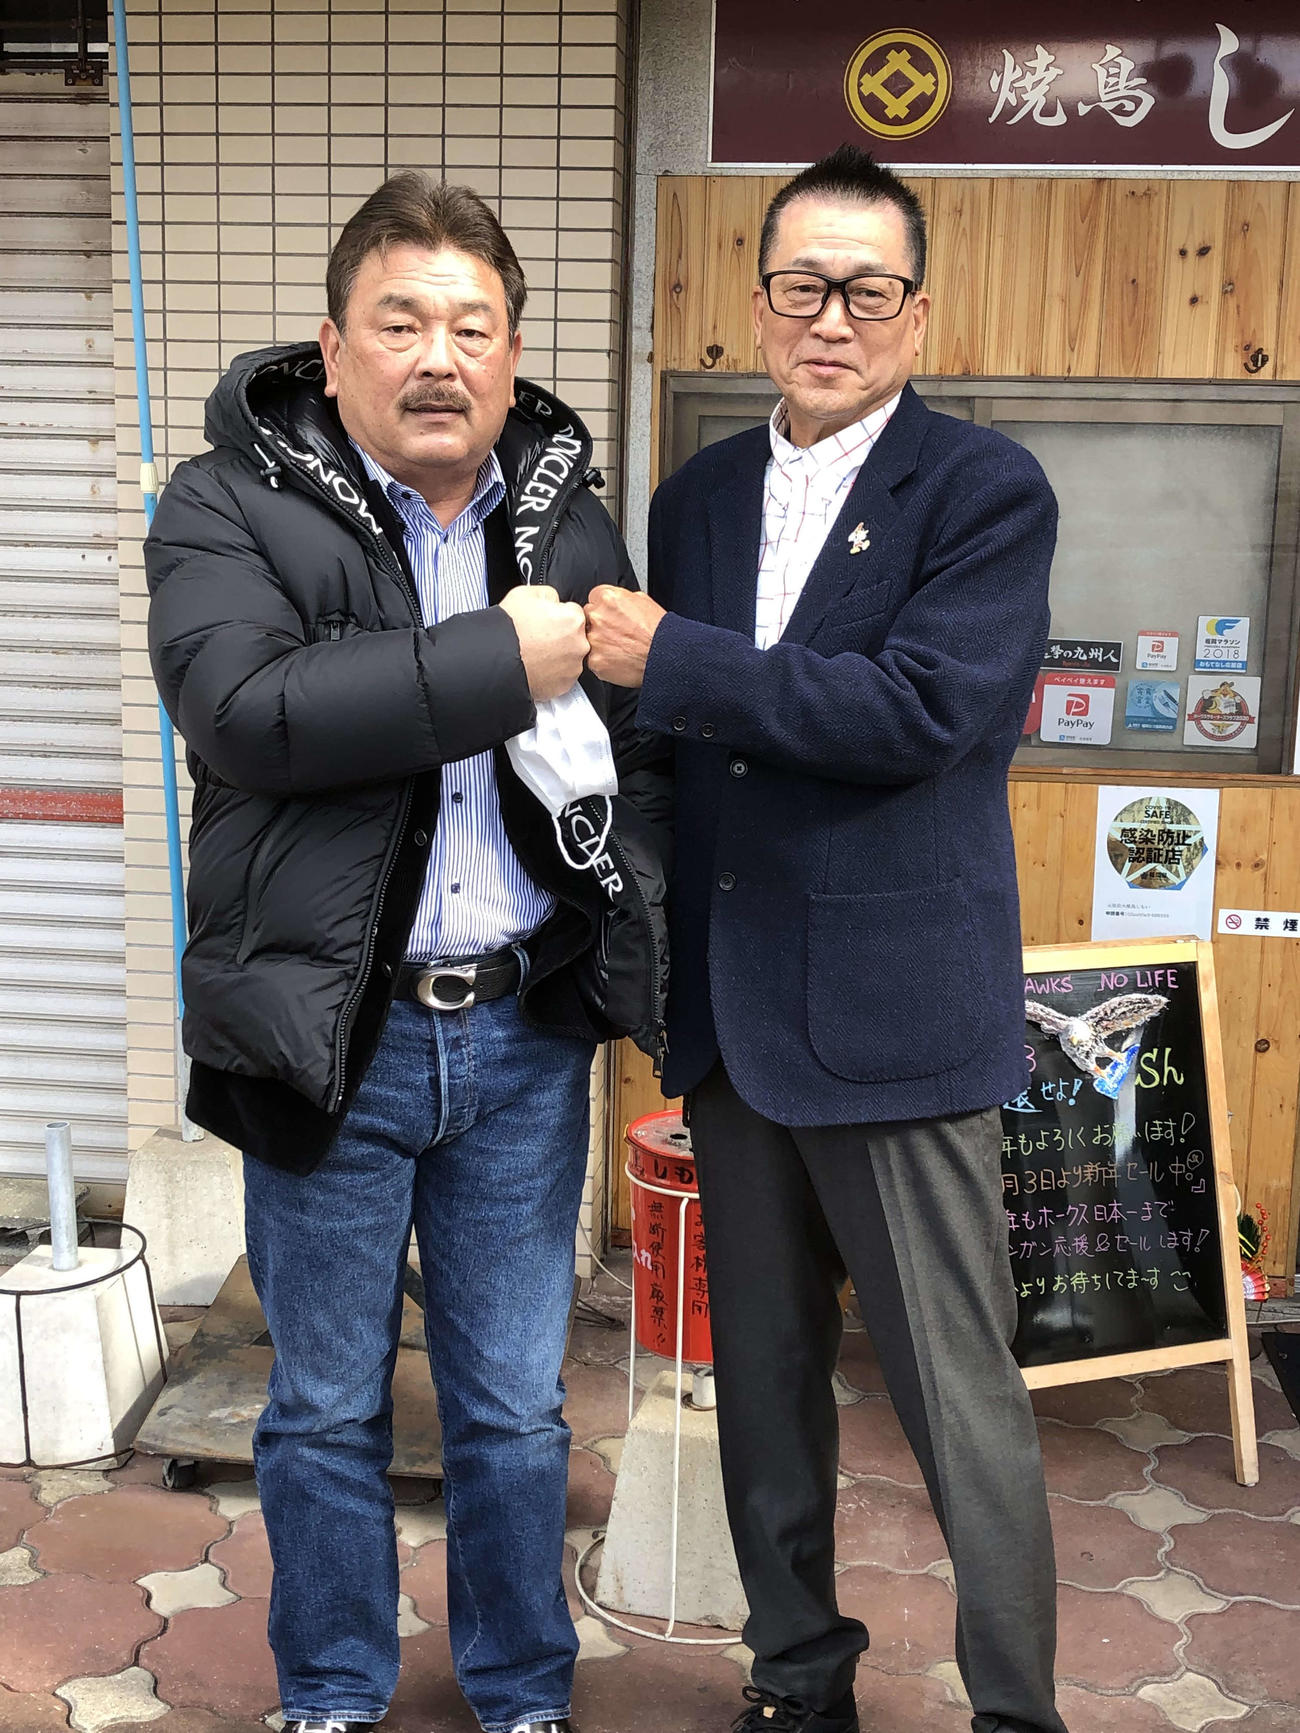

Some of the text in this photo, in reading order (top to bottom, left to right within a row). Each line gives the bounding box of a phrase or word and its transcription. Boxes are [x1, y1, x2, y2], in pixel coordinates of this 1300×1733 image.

[988, 22, 1296, 149] 焼鳥 し
[1203, 648, 1240, 659] 2018
[1057, 717, 1095, 730] PayPay
[1144, 809, 1171, 819] SAFE
[1120, 827, 1192, 846] 感染防止
[1128, 846, 1182, 865] 認証店
[1097, 972, 1129, 991] NO
[1135, 969, 1179, 989] LIFE
